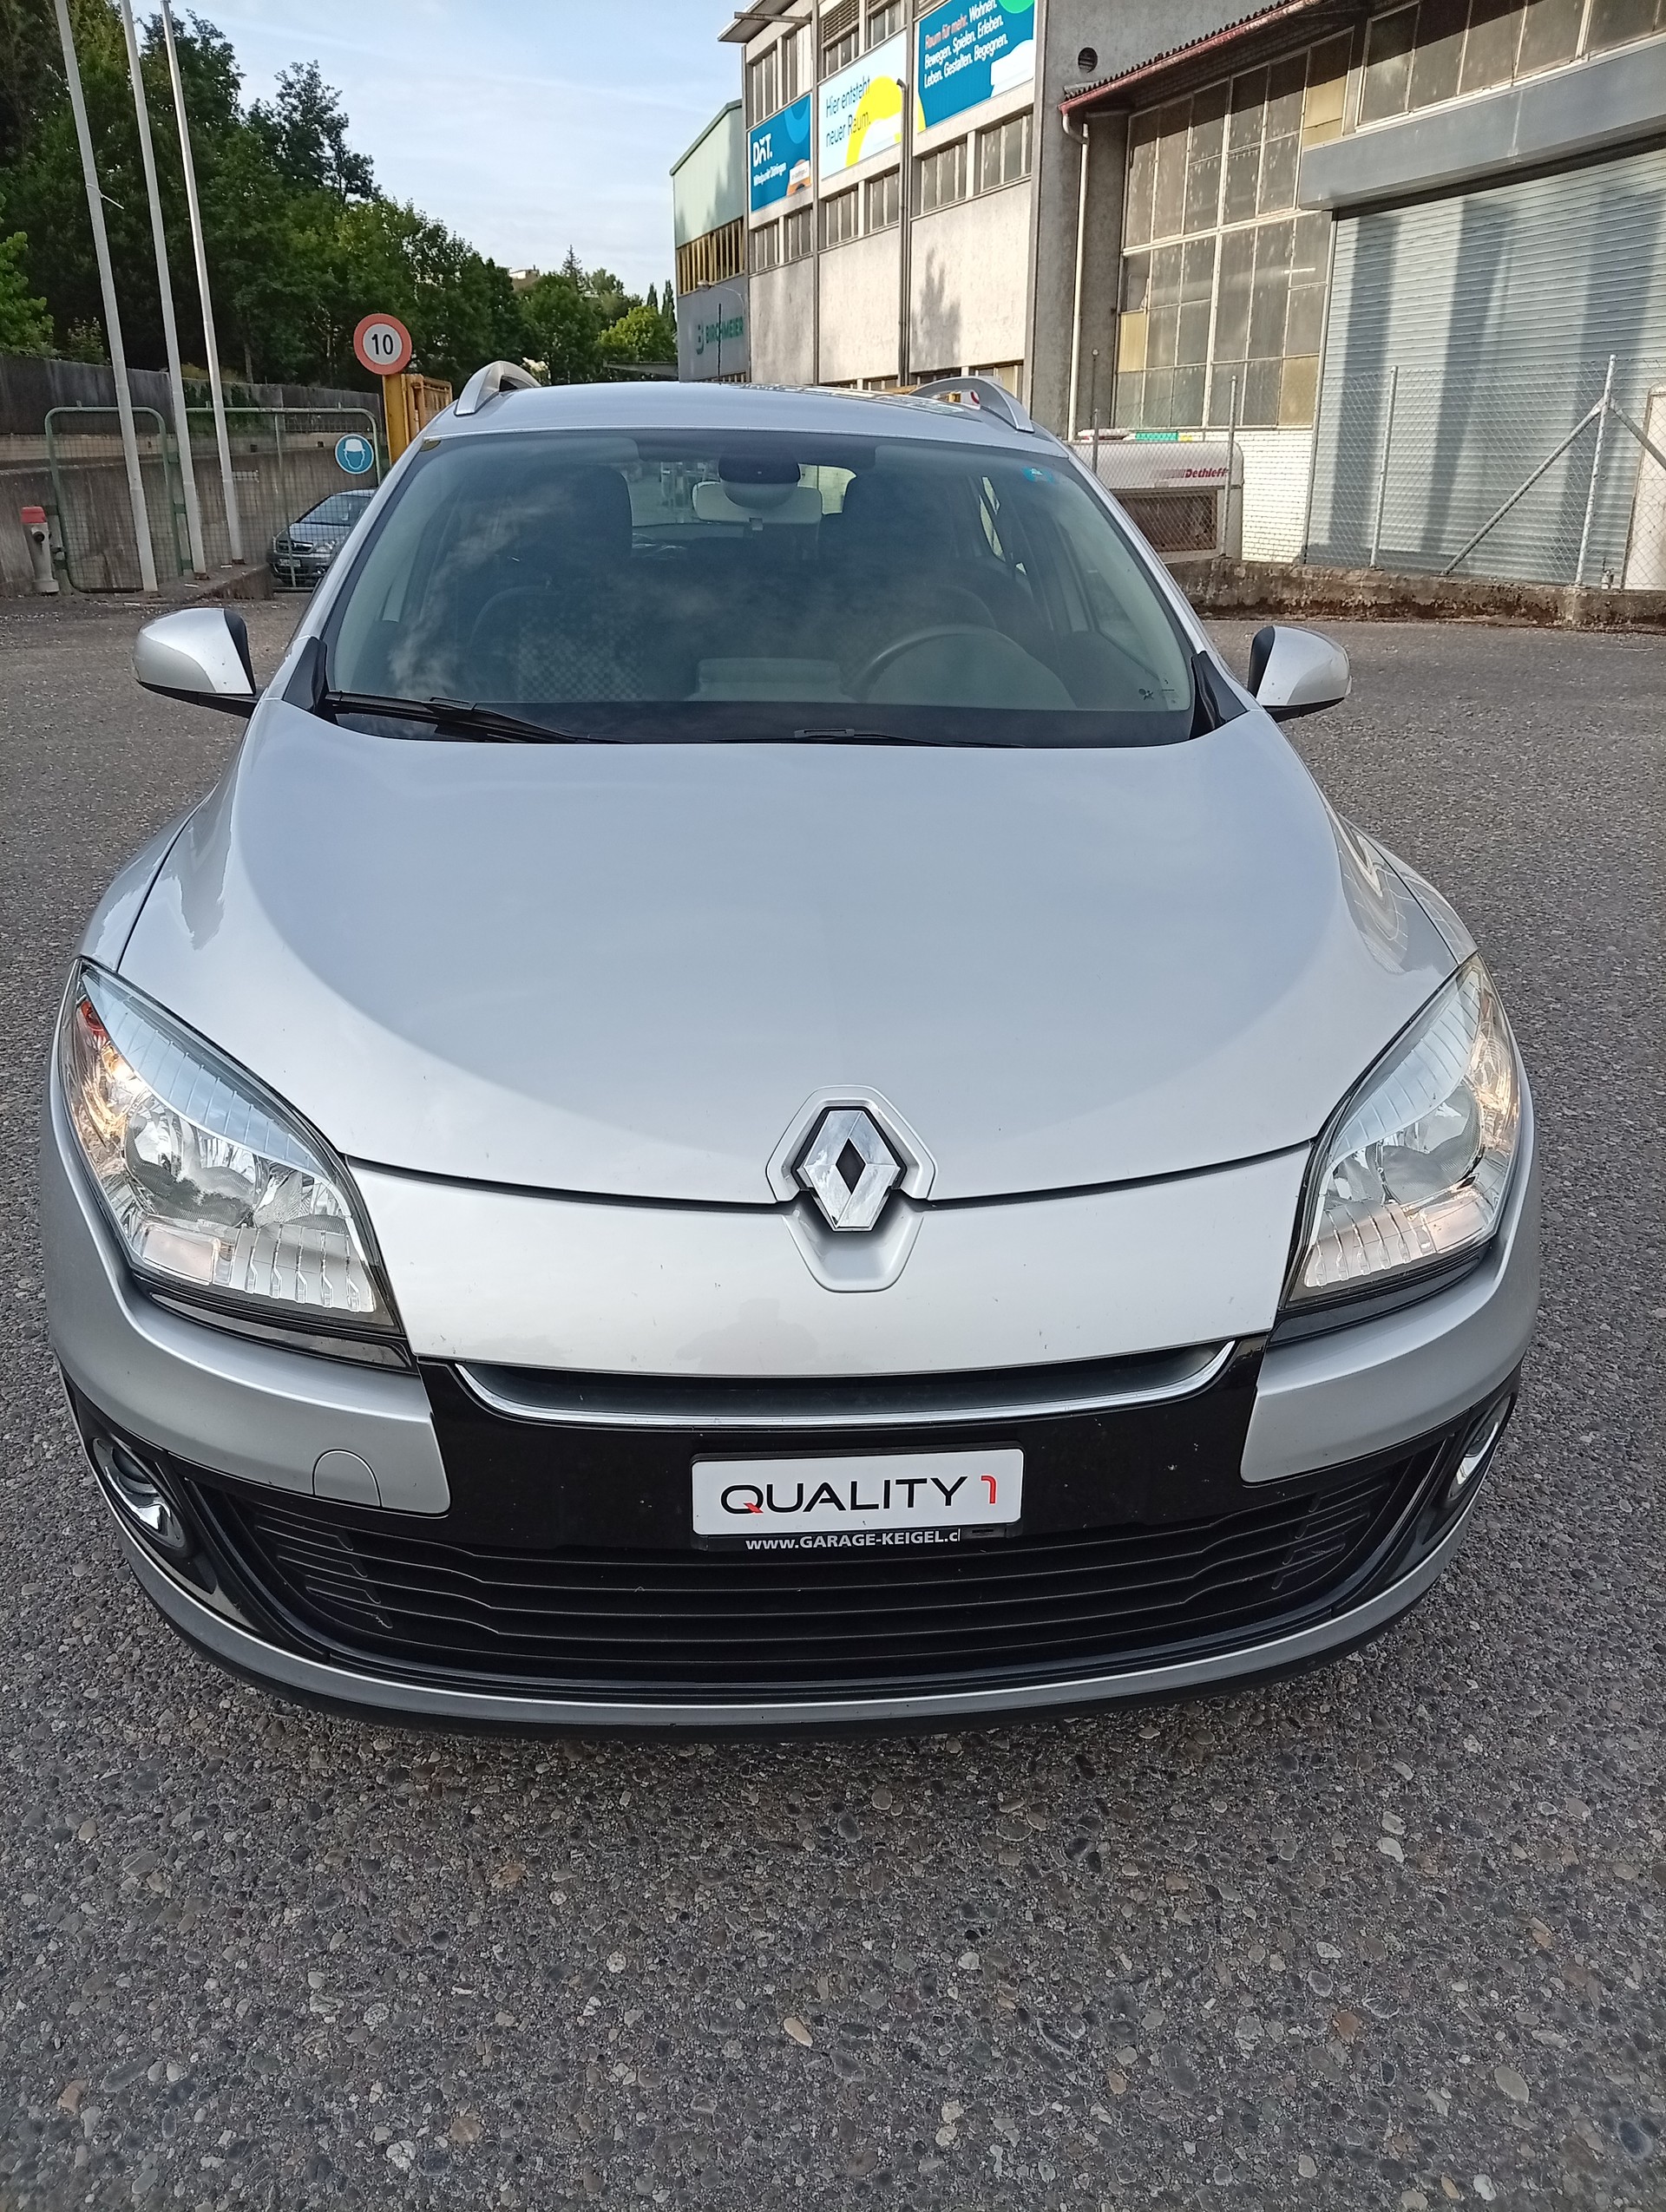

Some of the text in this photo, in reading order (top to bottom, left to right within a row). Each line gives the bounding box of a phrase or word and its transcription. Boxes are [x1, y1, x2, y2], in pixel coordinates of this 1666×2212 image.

[924, 14, 1004, 69] Bewegen. Spielen. Erleben.
[925, 29, 941, 50] Raum
[941, 24, 951, 39] für
[968, 0, 997, 23] Wohnen.
[924, 33, 1008, 88] Leben. Gestalten. Begegnen.
[825, 75, 870, 118] Hier entsteht
[825, 111, 871, 147] neuer Raum.
[371, 334, 394, 355] 10
[720, 1475, 997, 1515] QUALITY 1
